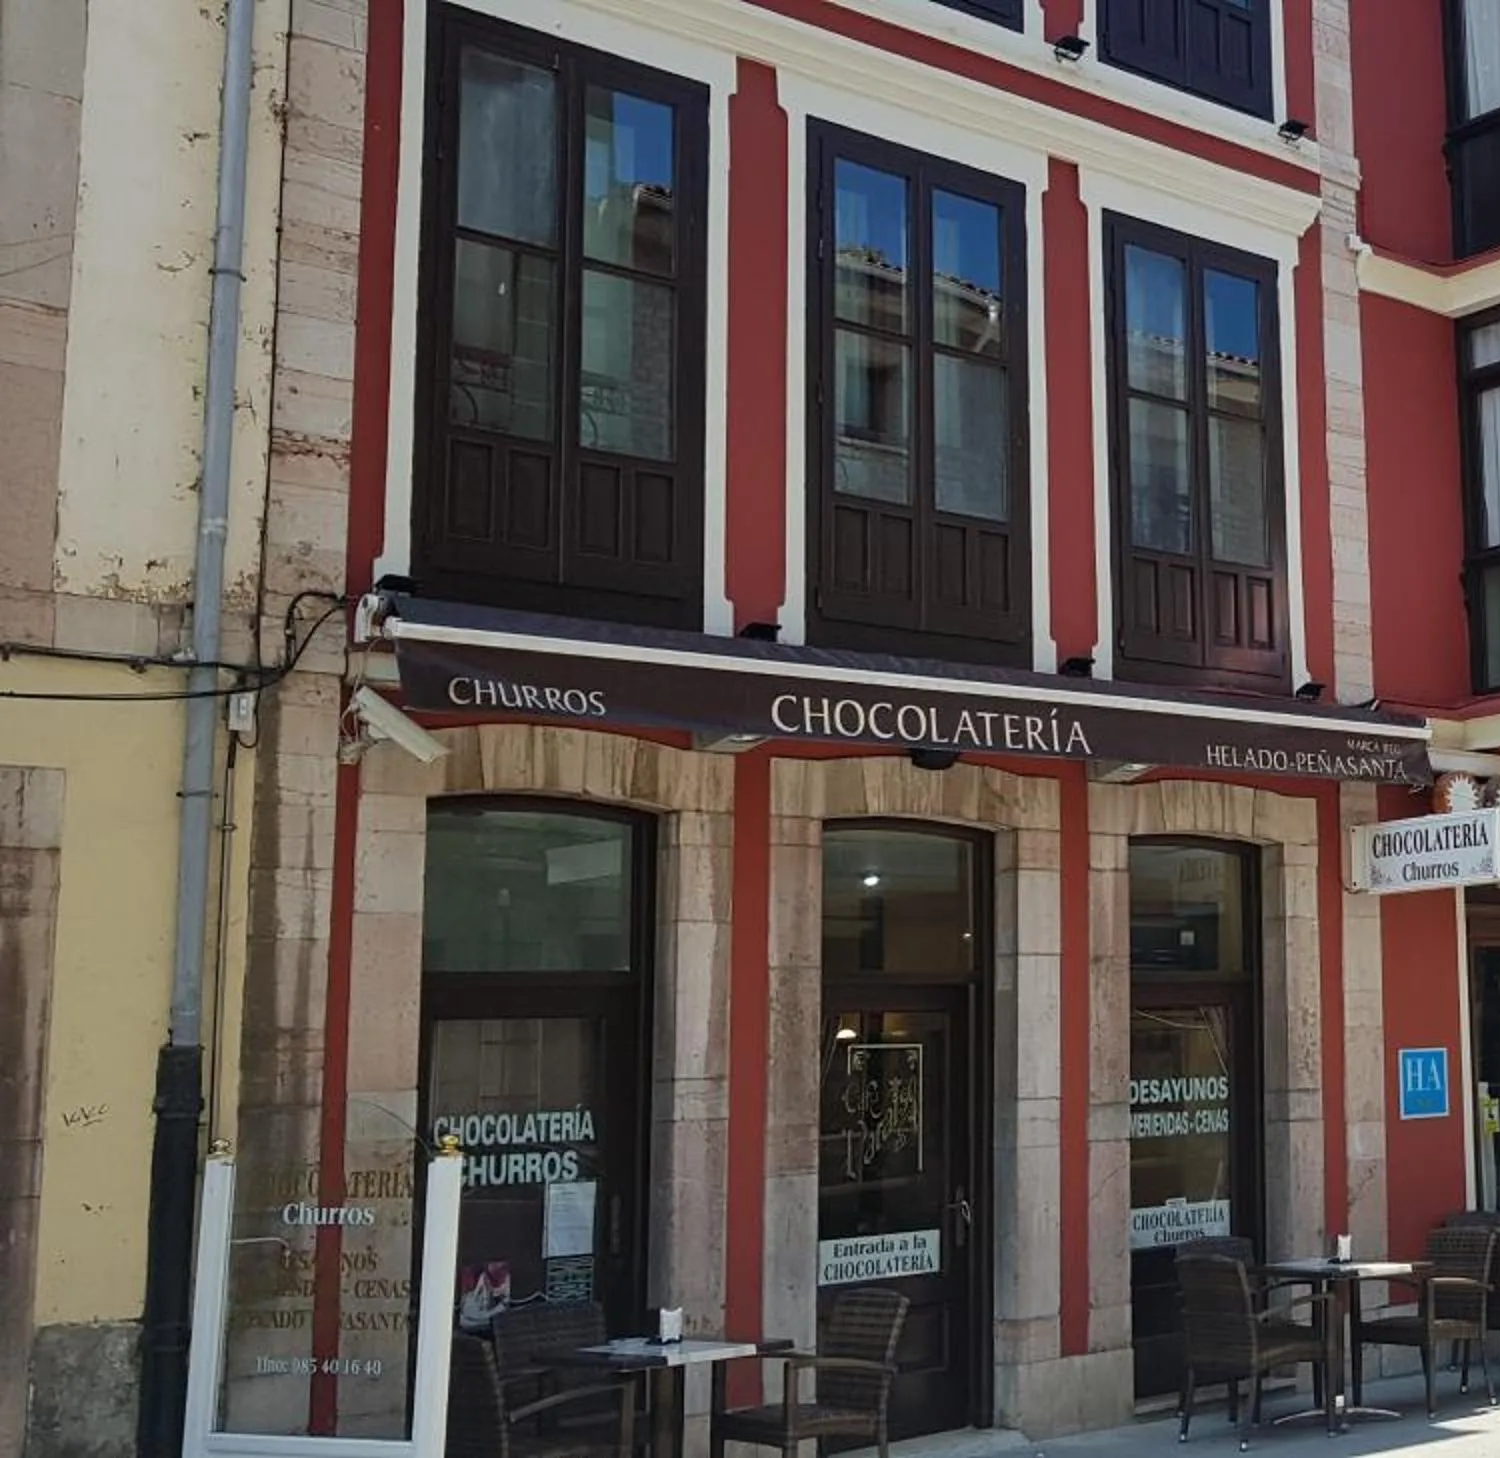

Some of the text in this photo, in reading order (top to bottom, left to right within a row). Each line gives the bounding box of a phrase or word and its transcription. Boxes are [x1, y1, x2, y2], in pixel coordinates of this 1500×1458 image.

[448, 677, 606, 716] CHURROS
[771, 694, 1093, 755] CHOCOLATERÍA
[1372, 819, 1489, 859] CHOCOLATERÍA
[1403, 861, 1460, 882] Churros
[1406, 1056, 1442, 1092] HA
[1130, 1076, 1229, 1104] DESAYUNOS
[434, 1104, 595, 1148] CHOCOLATERÍA
[461, 1151, 578, 1187] HURROS
[282, 1201, 375, 1226] Churros
[1133, 1206, 1225, 1231] CHOCOLATERÍA
[833, 1233, 927, 1258] Entrada a la
[824, 1251, 933, 1281] CHOCOLATERÍA
[344, 1359, 361, 1375] 16
[364, 1359, 382, 1375] 40
